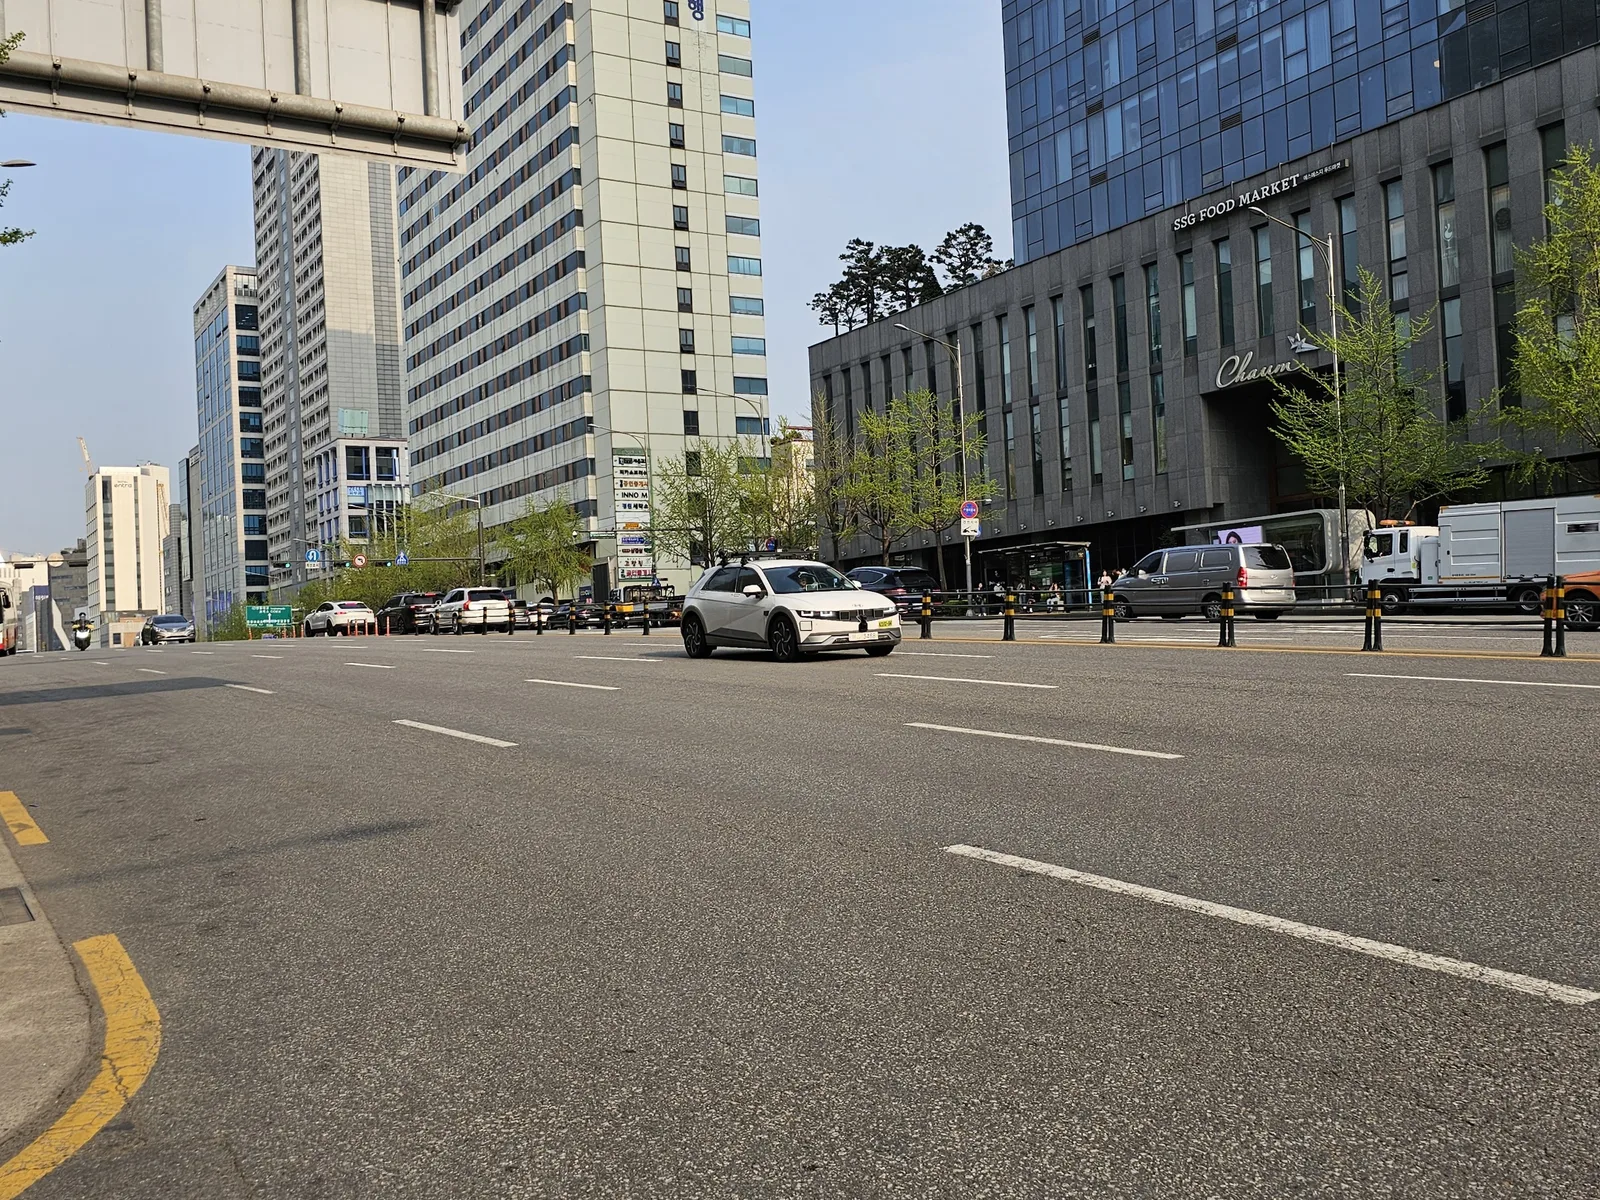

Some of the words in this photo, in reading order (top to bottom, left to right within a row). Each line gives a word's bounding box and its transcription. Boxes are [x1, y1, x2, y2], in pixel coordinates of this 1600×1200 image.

[1303, 168, 1324, 180] 에스에스지
[1173, 213, 1196, 231] SSG
[1199, 199, 1235, 222] FOOD
[1238, 173, 1300, 207] MARKET
[1215, 350, 1302, 389] Chaum
